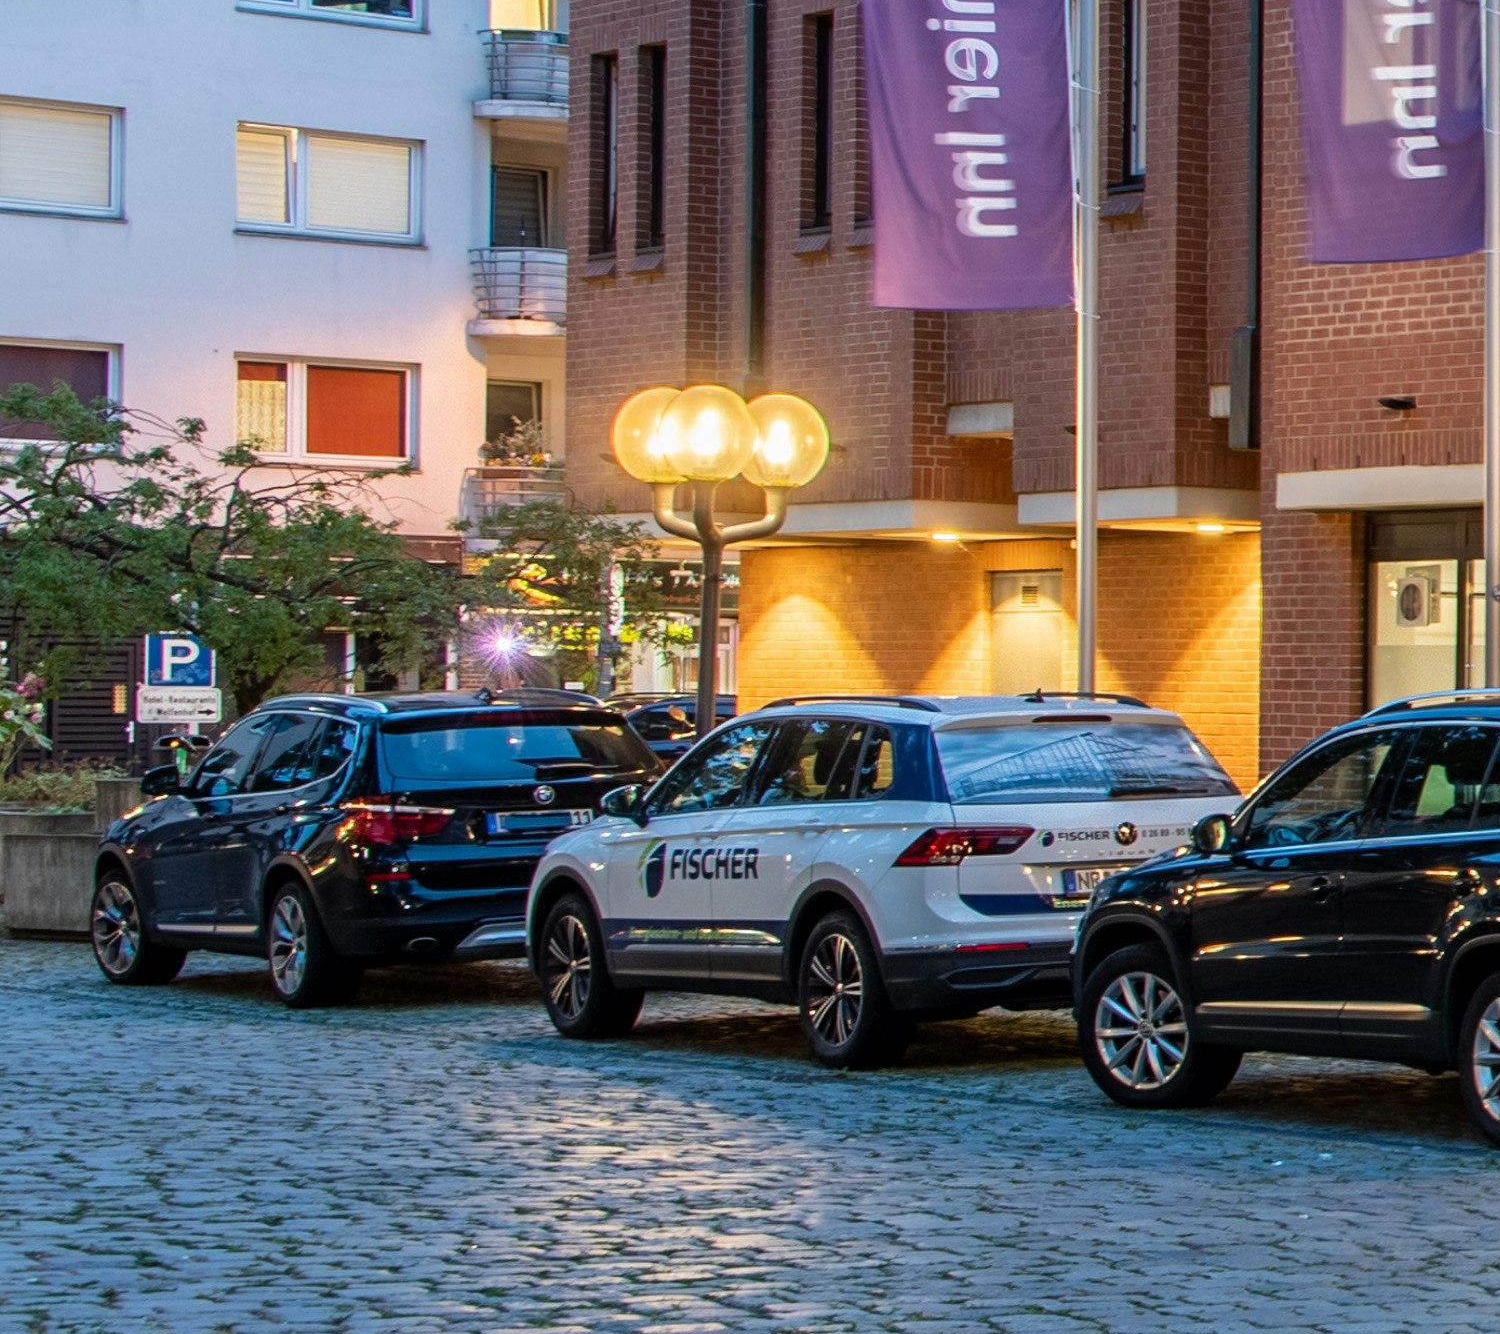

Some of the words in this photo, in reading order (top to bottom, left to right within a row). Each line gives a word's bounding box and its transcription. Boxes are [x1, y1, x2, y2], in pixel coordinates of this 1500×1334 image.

[162, 639, 200, 681] P
[1057, 829, 1111, 843] FISCHER
[670, 847, 760, 880] FISCHER
